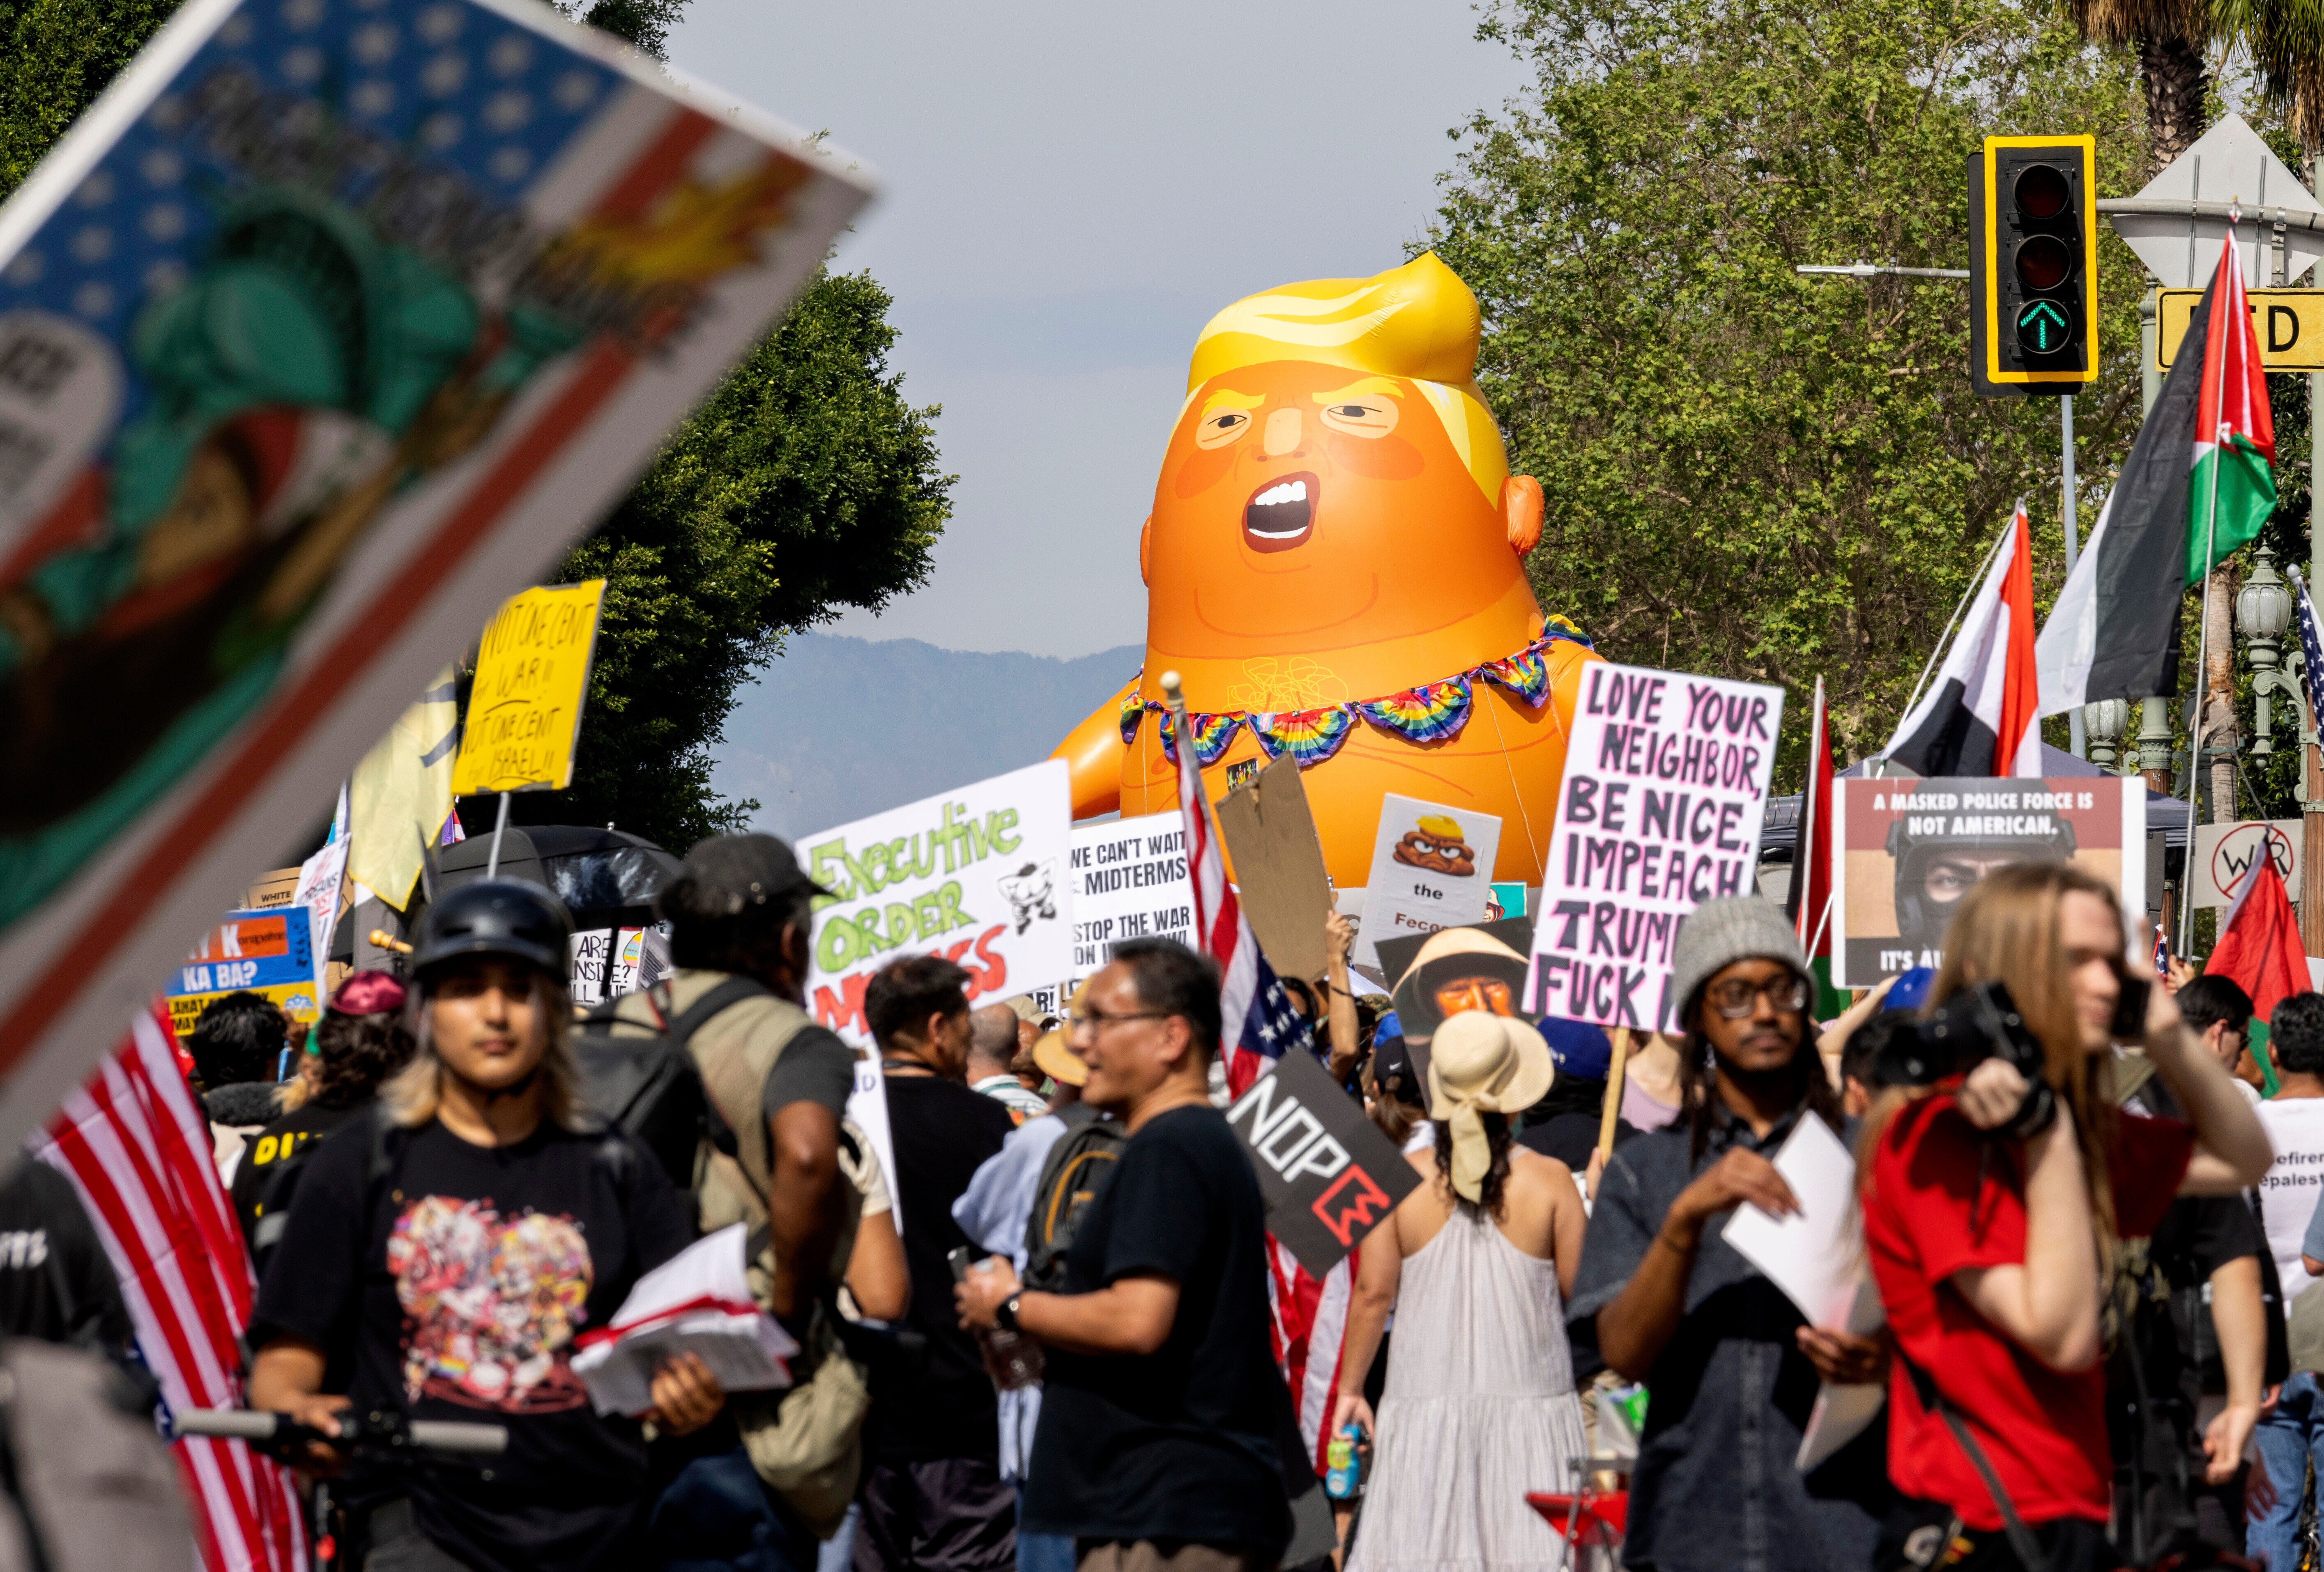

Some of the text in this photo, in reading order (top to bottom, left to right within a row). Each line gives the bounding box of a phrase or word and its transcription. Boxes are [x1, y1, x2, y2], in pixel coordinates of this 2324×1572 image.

[548, 602, 595, 650] CENT
[1588, 668, 1768, 741] LOVE YOUR
[515, 707, 561, 741] CENT
[1600, 723, 1761, 801] NEIGHBOR,
[1566, 775, 1749, 853] BE NICE.
[1873, 792, 2094, 811] A MASKED POLICE FORCE IS
[1908, 815, 2058, 836] NOT AMERICAN.
[1096, 838, 1141, 864] CAN'T
[1148, 831, 1185, 855] WAIT
[2222, 842, 2288, 877] WR
[1085, 857, 1186, 896] MIDTERMS
[1565, 833, 1744, 903] IMPEACH
[261, 891, 291, 902] WHITE
[1413, 884, 1443, 899] the
[816, 880, 978, 974] ORDER
[1072, 918, 1113, 942] STOP
[1118, 913, 1150, 938] THE
[1153, 906, 1190, 931] WAR
[577, 935, 613, 958] ARE
[1075, 944, 1095, 965] ON
[1880, 949, 1914, 972] IT'S
[183, 961, 258, 992] KA BA?
[1535, 954, 1646, 1028] FUCK
